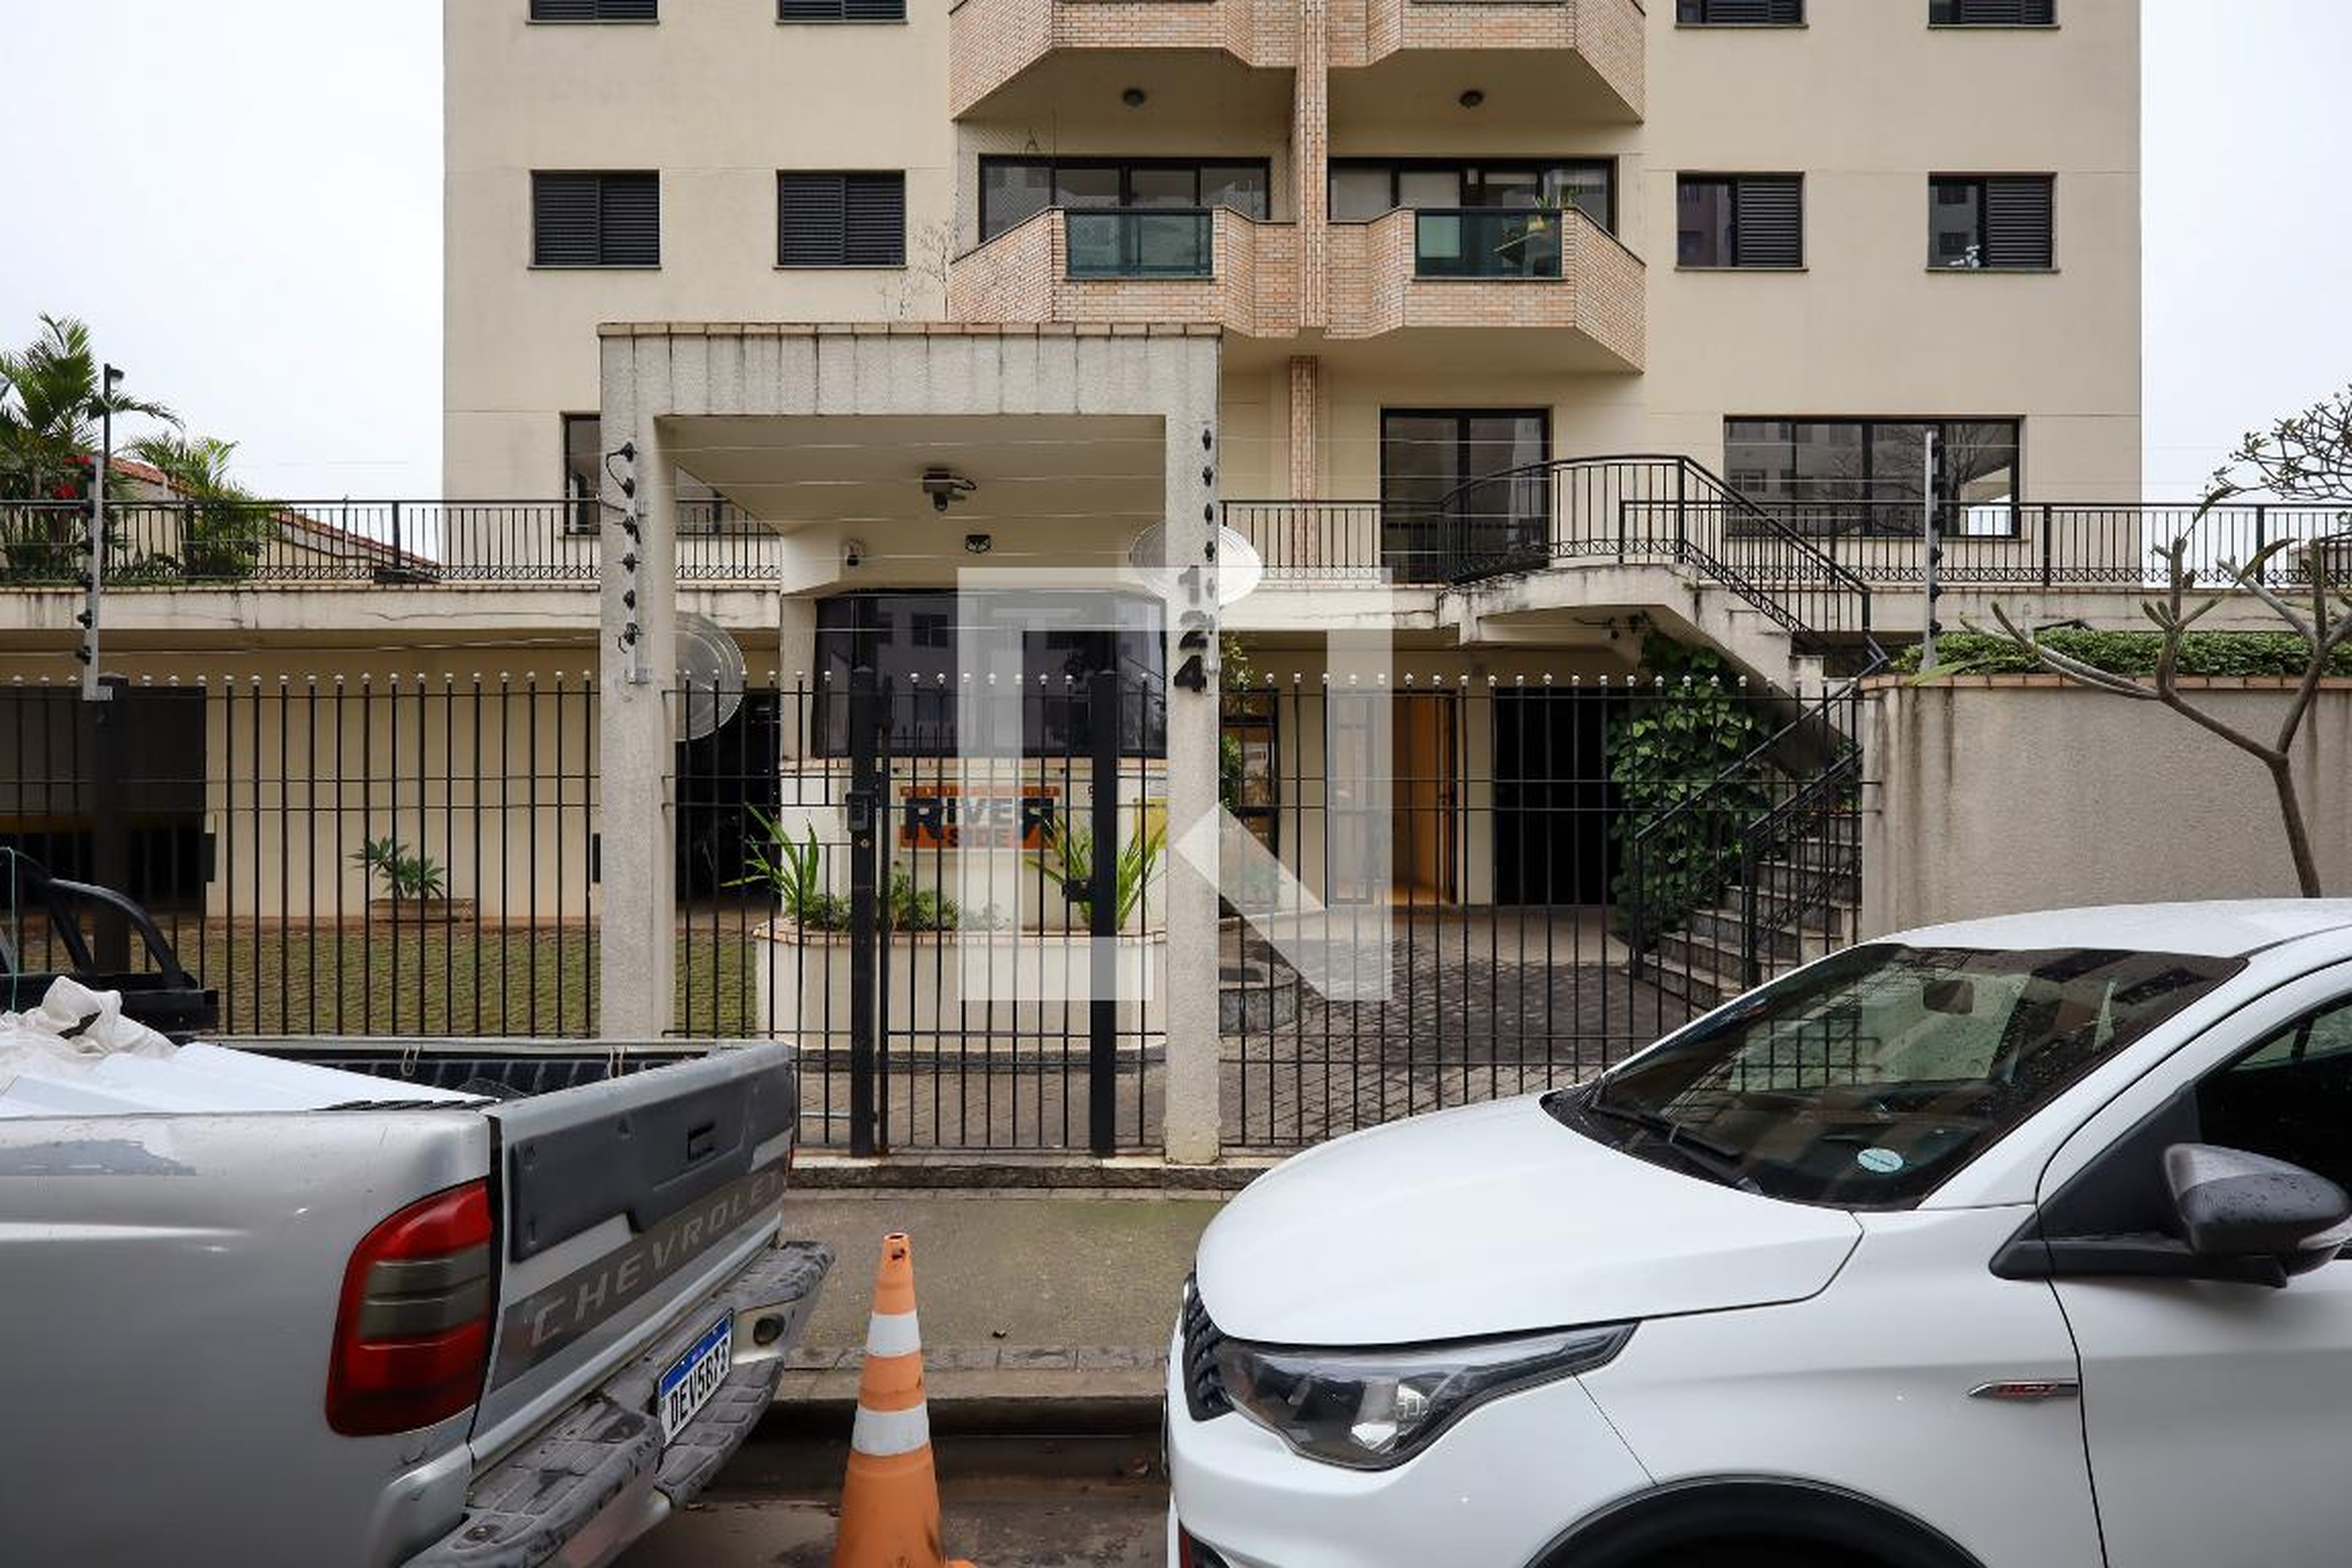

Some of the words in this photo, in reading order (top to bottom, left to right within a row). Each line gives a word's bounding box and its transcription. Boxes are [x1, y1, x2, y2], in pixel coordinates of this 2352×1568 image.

[1174, 565, 1207, 692] 124
[905, 797, 1054, 840] RIVER
[948, 829, 1010, 847] SIDE
[532, 1173, 780, 1347] CHEVROLET
